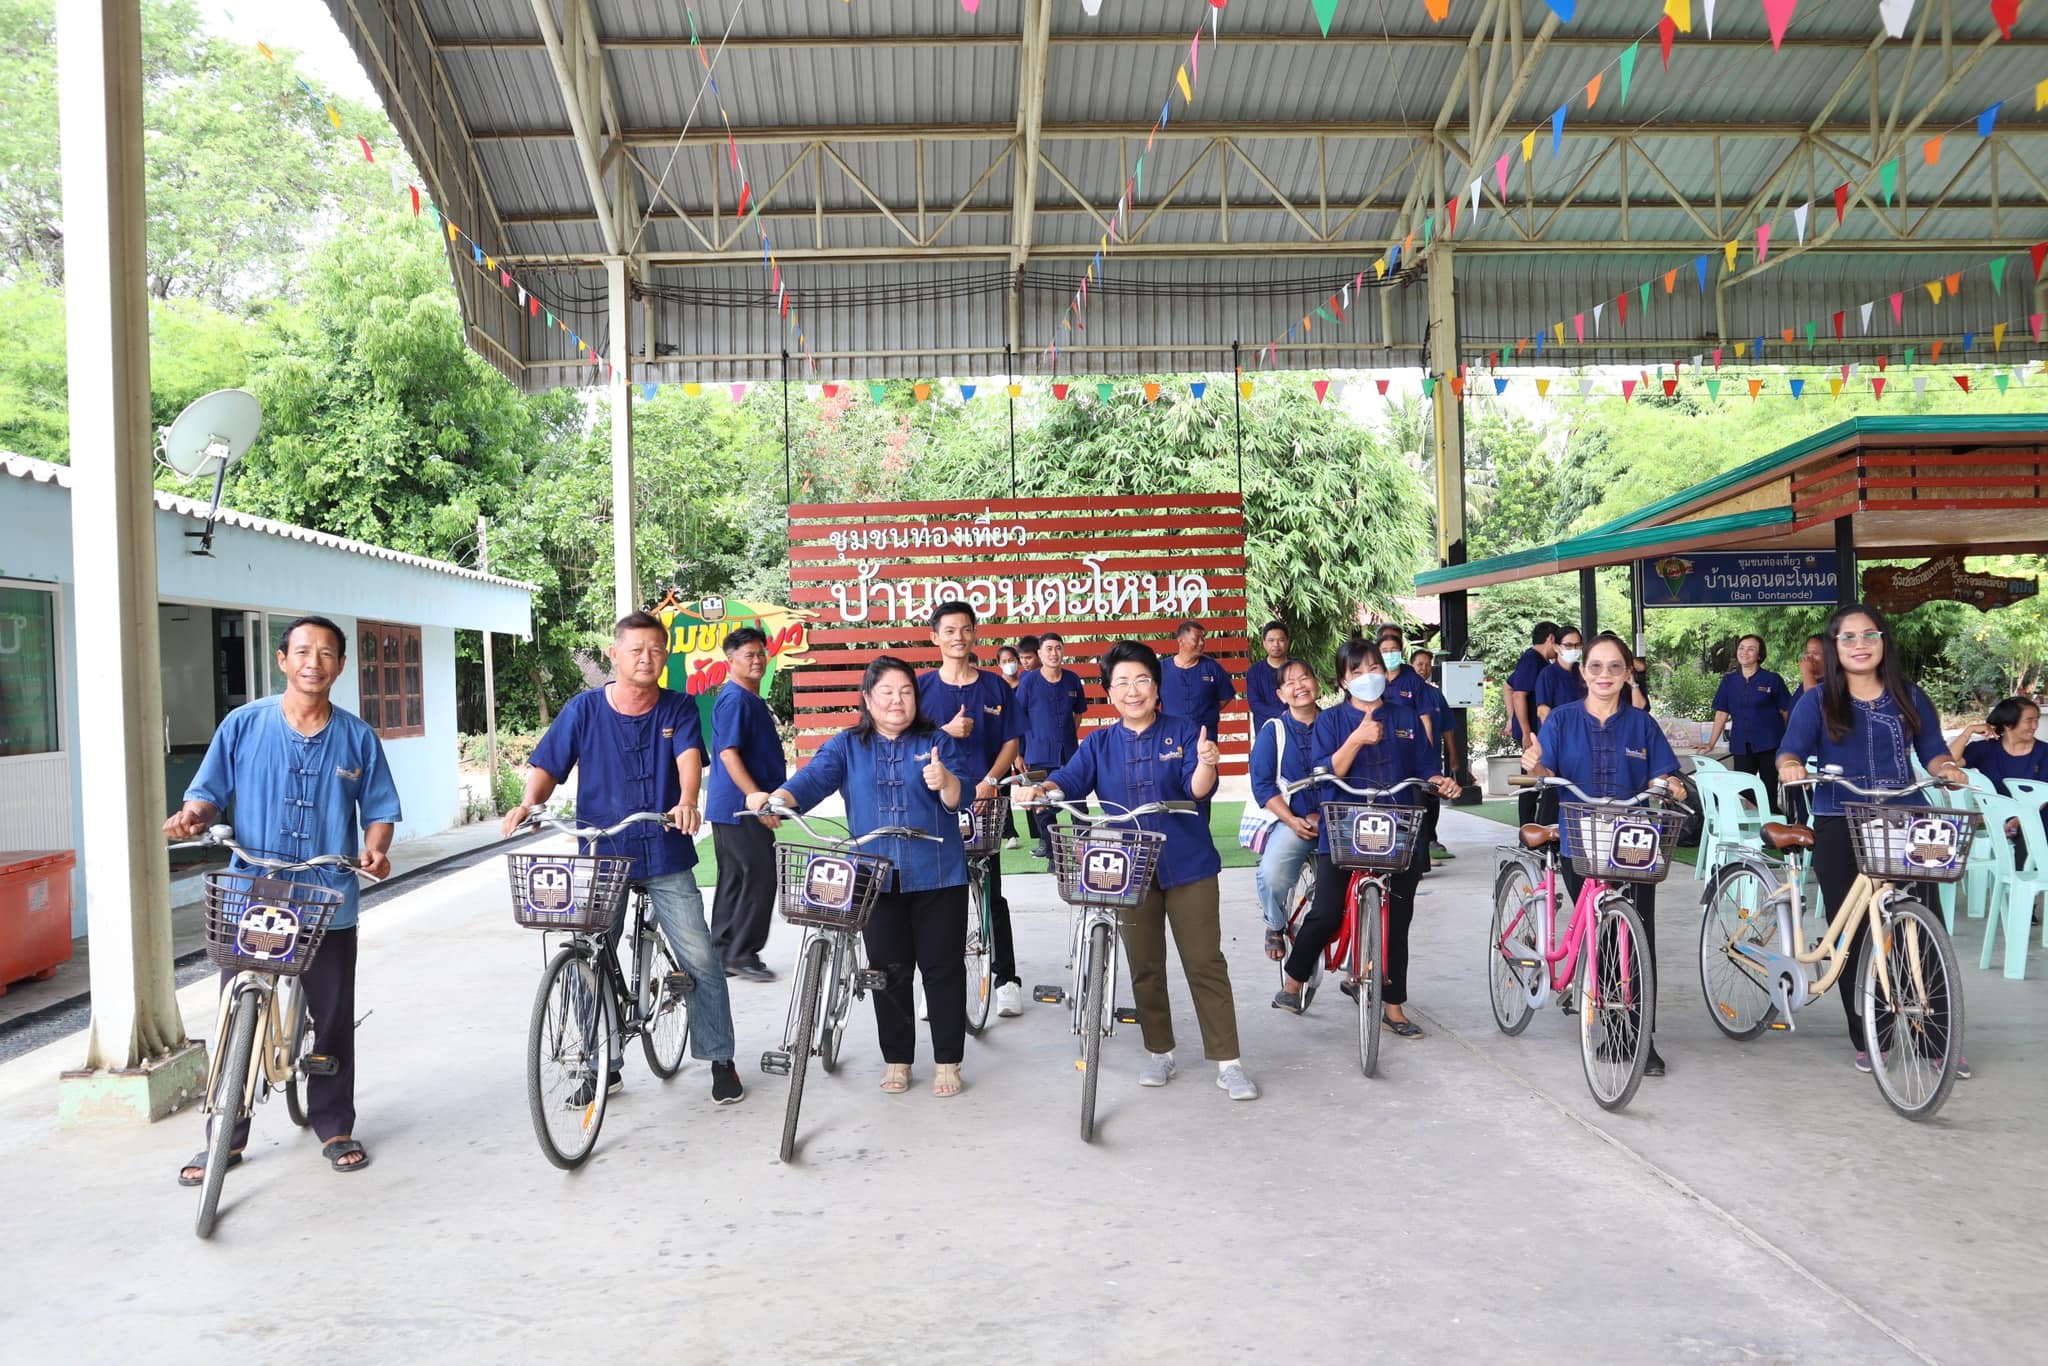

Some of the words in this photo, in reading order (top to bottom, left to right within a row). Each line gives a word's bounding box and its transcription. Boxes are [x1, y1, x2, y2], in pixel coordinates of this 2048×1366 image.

[829, 506, 1027, 562] ชุมชนท่องเที่ยว
[830, 553, 1209, 622] บ้านดอนตะโหนด
[1704, 567, 1838, 589] บ้านดอนตะโหนด
[1730, 591, 1752, 600] (Ban
[1758, 590, 1813, 600] Dontanode)
